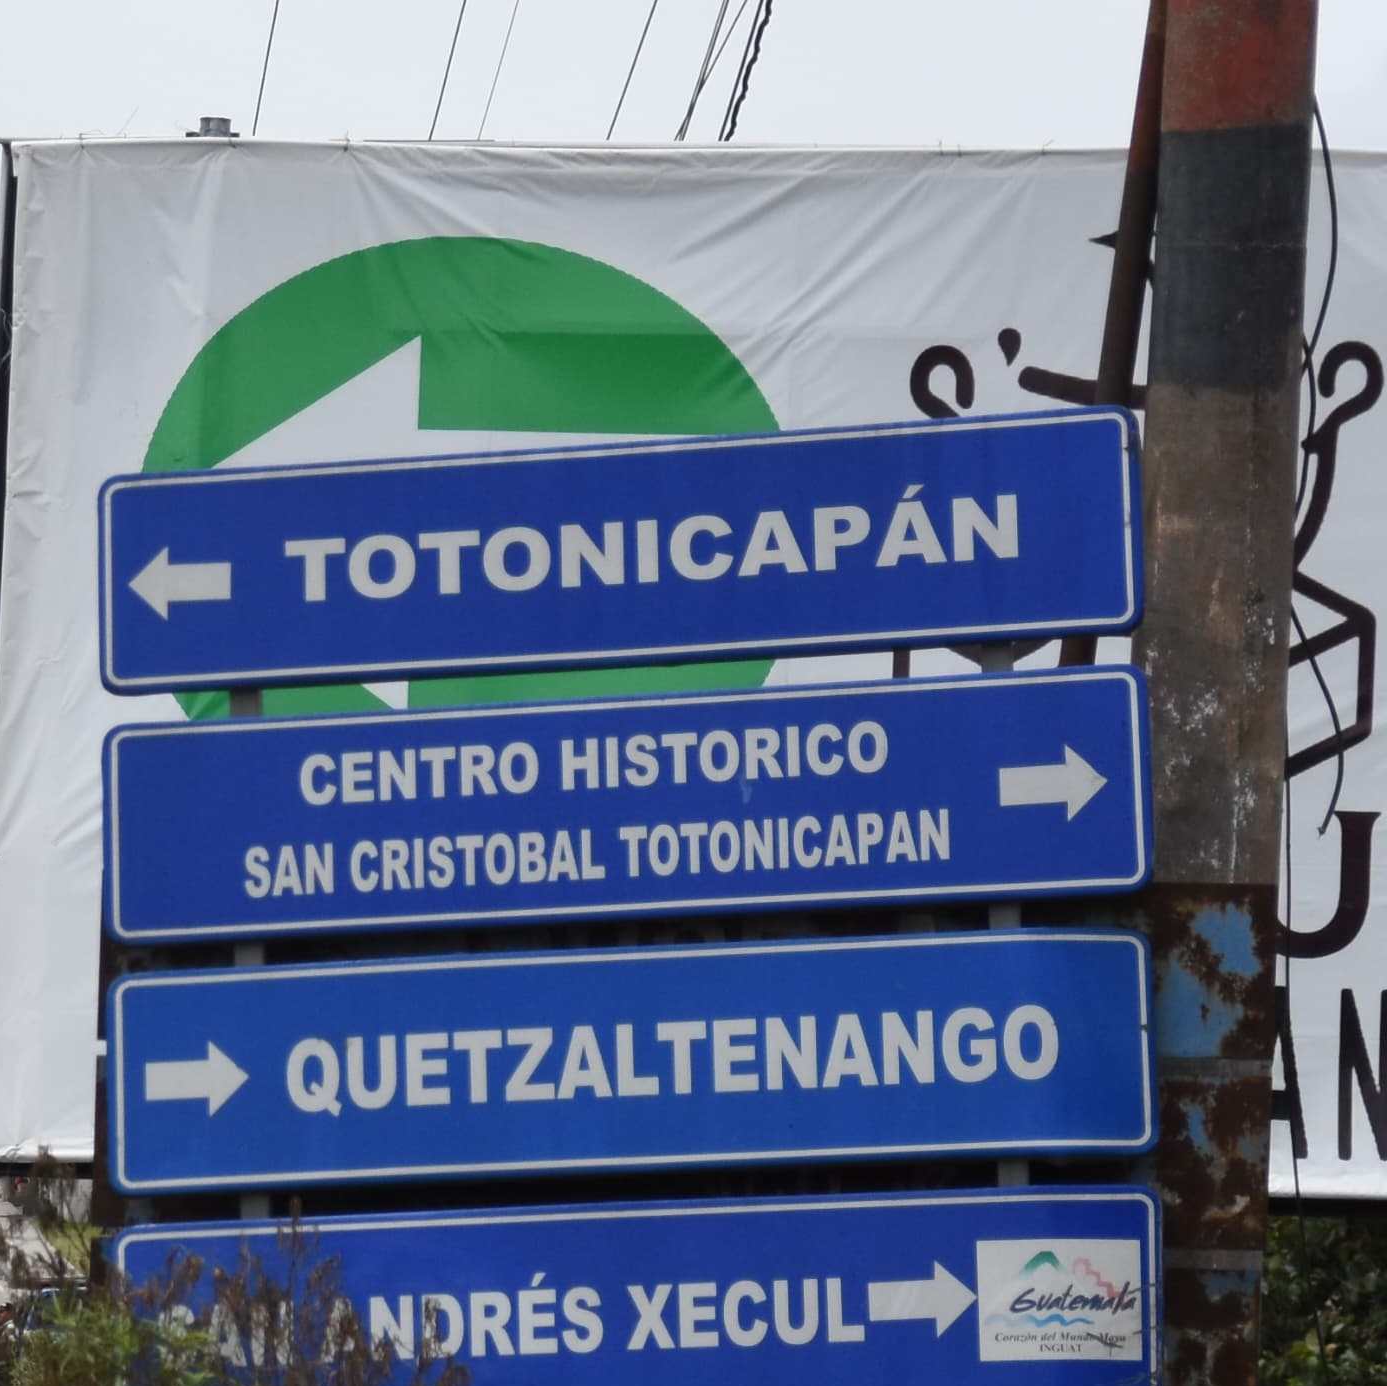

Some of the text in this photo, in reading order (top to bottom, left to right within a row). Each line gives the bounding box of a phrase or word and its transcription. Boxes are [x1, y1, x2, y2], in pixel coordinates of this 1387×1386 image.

[285, 484, 1019, 602] TOTONICAPÁN
[300, 720, 888, 806] CENTRO HISTORICO
[244, 808, 951, 898] SAN CRISTOBAL TOTONICAPAN
[287, 1004, 1059, 1117] QUETZALTENANGO
[627, 1278, 865, 1351] XECUL
[994, 1331, 1037, 1343] Corazón
[1040, 1331, 1057, 1342] del
[1040, 1343, 1082, 1353] INGUAT
